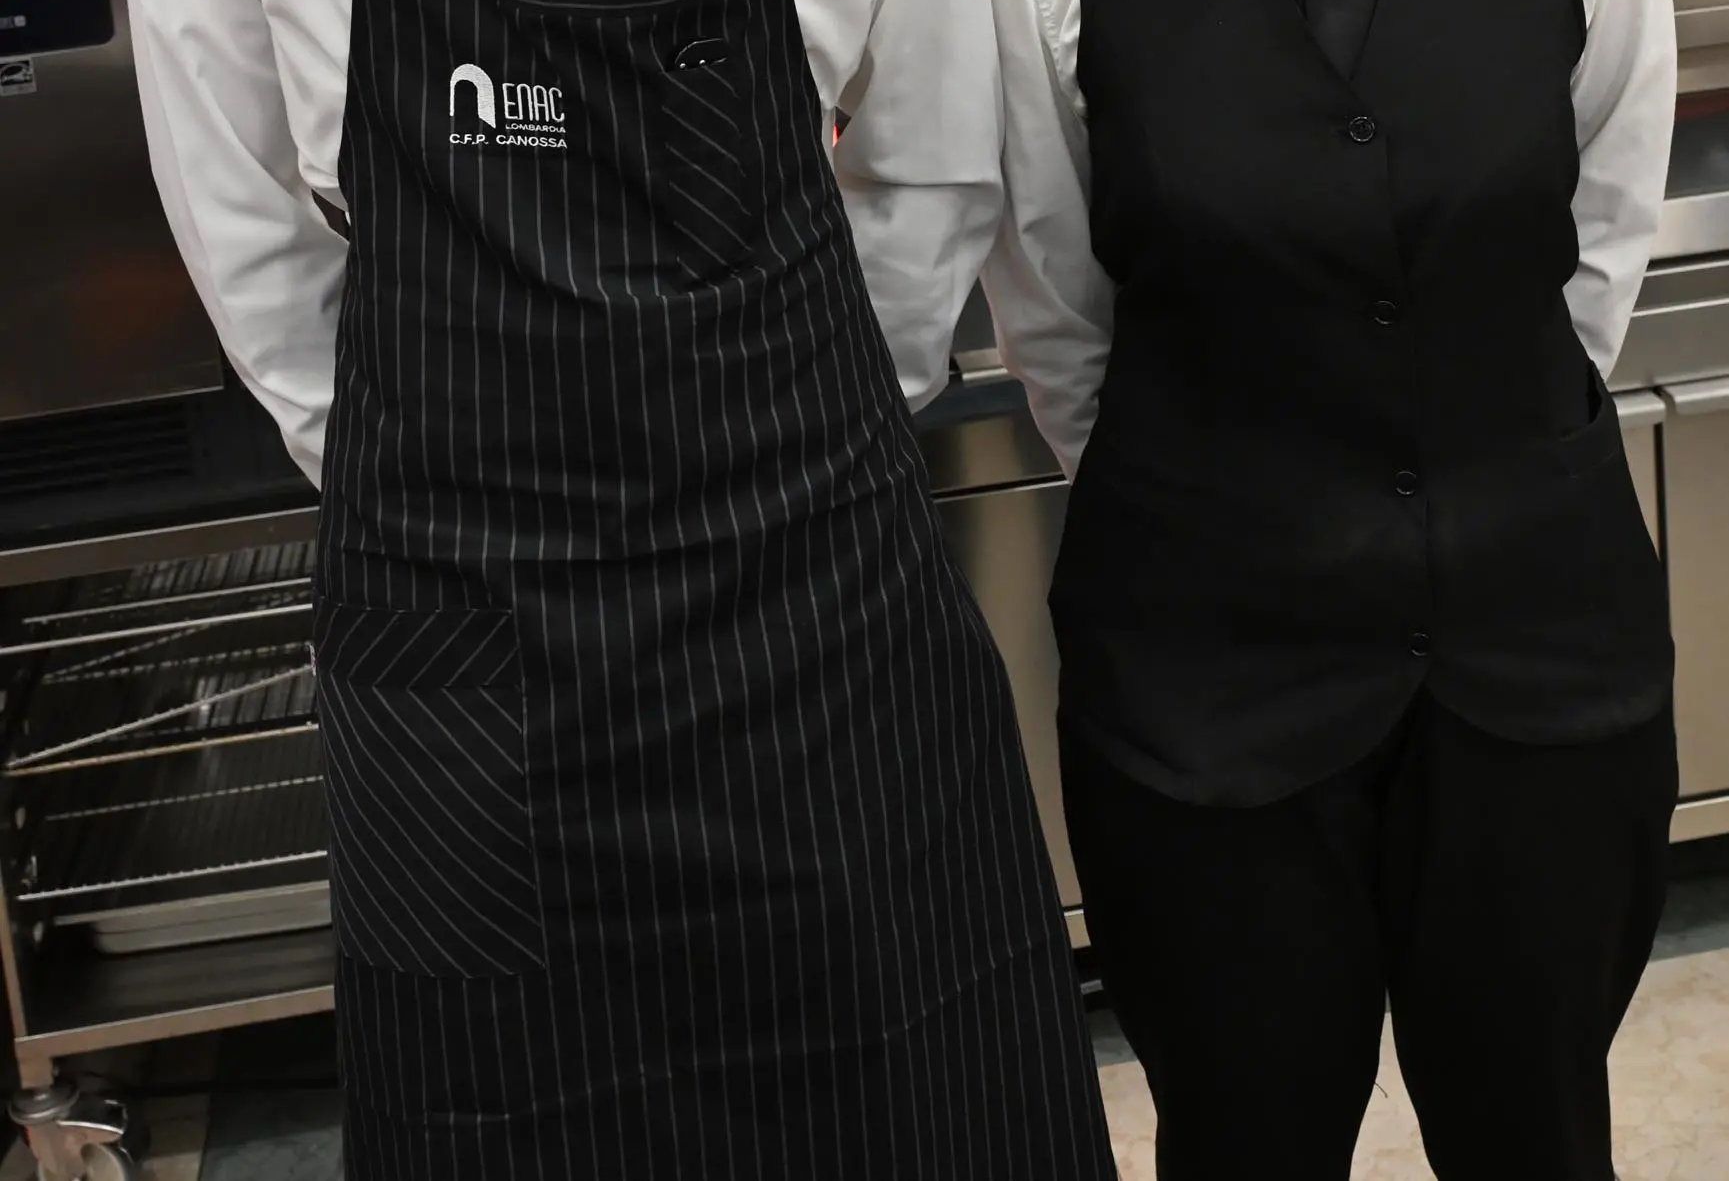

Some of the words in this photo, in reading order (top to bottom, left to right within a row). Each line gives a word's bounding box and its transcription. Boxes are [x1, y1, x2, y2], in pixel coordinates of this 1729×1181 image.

[502, 82, 565, 122] ENAC
[505, 122, 566, 133] LOMBARDIA
[495, 134, 568, 149] CANOSSA
